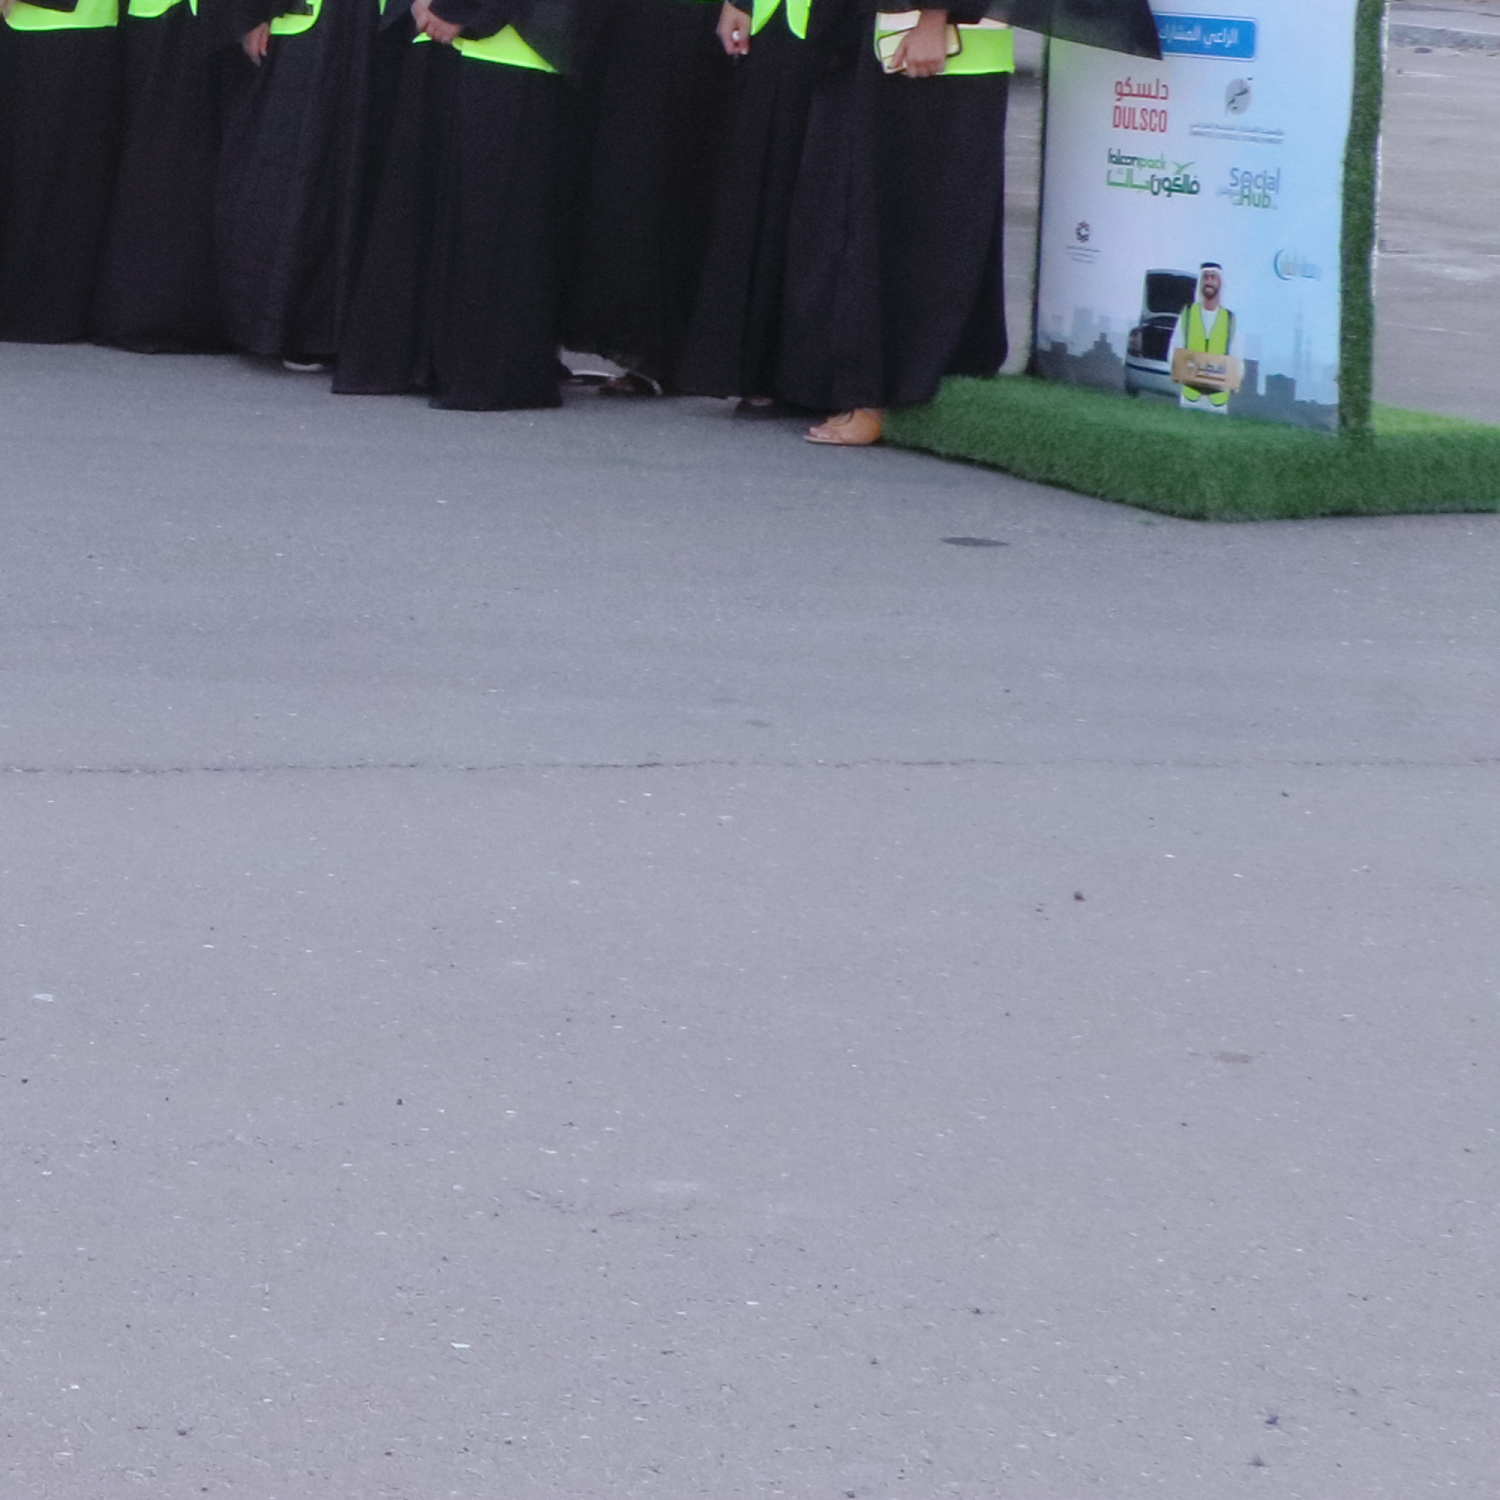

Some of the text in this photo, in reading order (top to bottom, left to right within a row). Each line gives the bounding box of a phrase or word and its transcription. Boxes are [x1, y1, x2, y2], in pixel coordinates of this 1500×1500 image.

[1203, 28, 1239, 48] الراعي
[1115, 76, 1169, 102] دلسكو
[1112, 105, 1168, 133] DULSCO
[1229, 167, 1281, 194] Social
